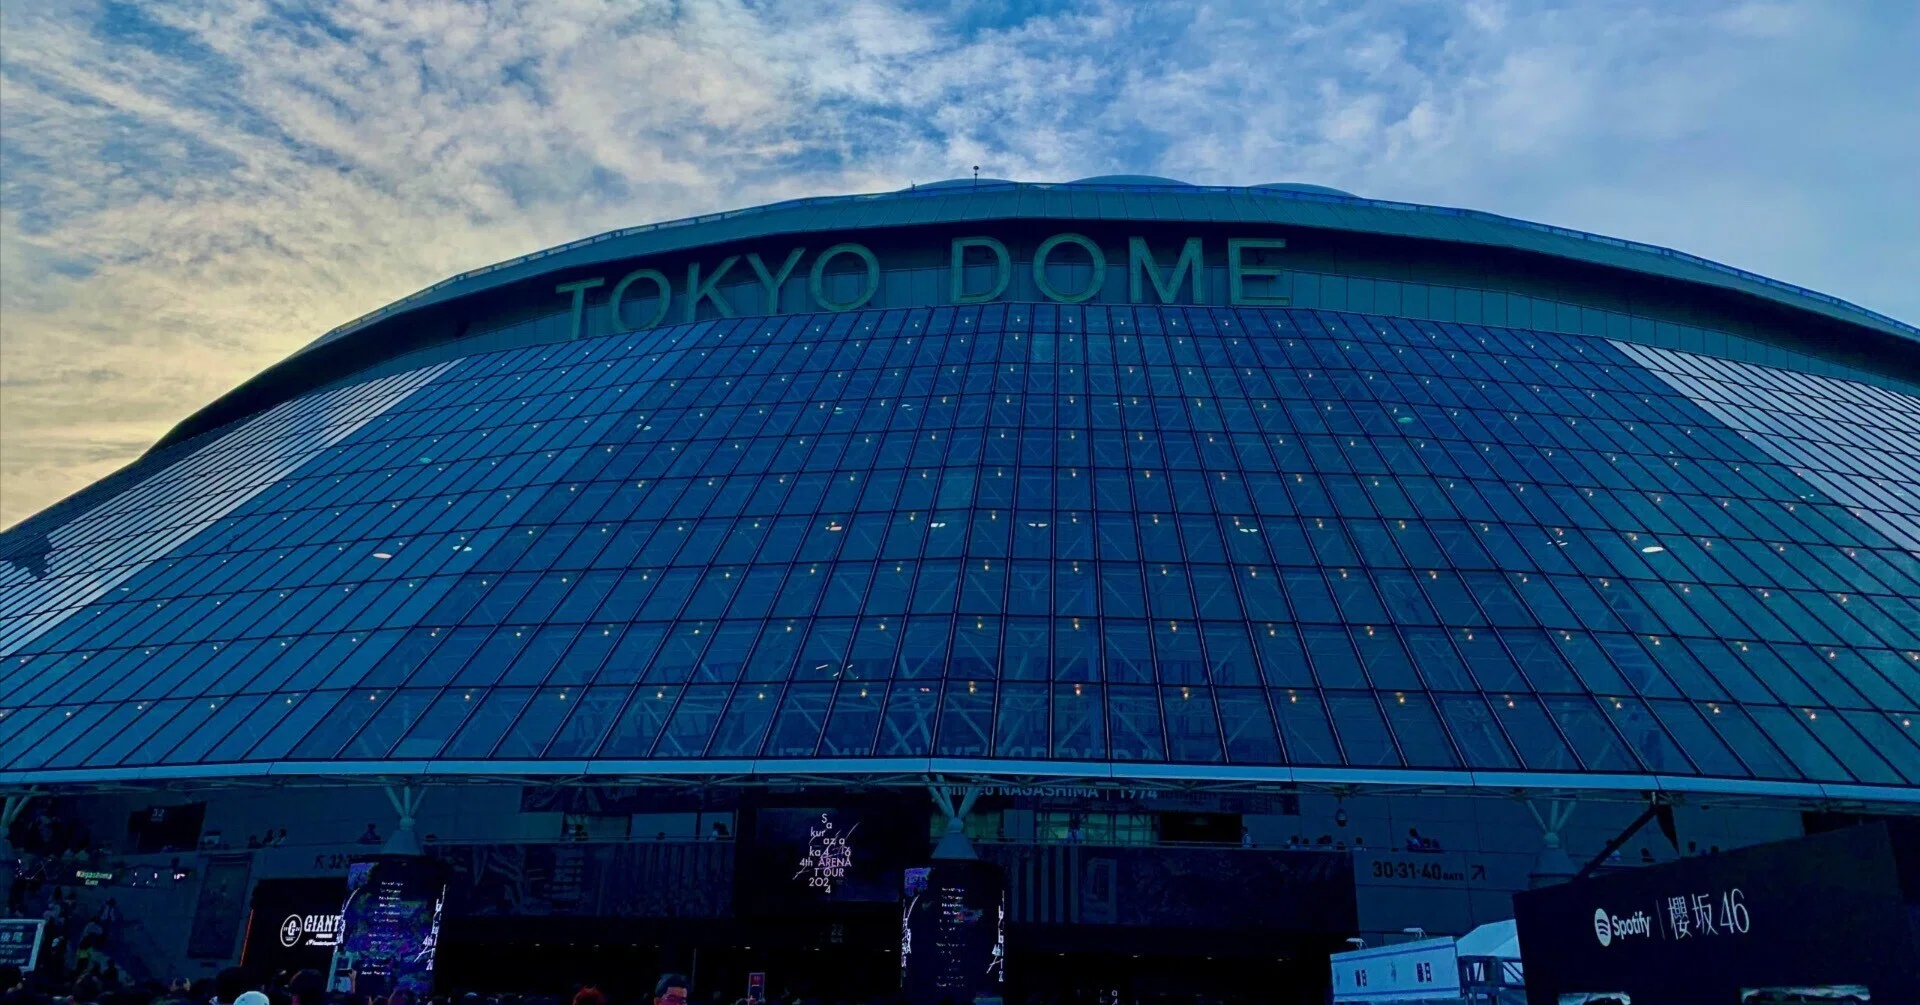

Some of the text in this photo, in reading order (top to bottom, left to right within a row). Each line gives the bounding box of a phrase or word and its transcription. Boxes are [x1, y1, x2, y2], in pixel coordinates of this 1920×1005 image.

[555, 232, 1292, 340] TOKYO DOME
[818, 857, 852, 867] ARENA
[304, 914, 342, 932] GIANT
[1611, 911, 1651, 940] Spotify
